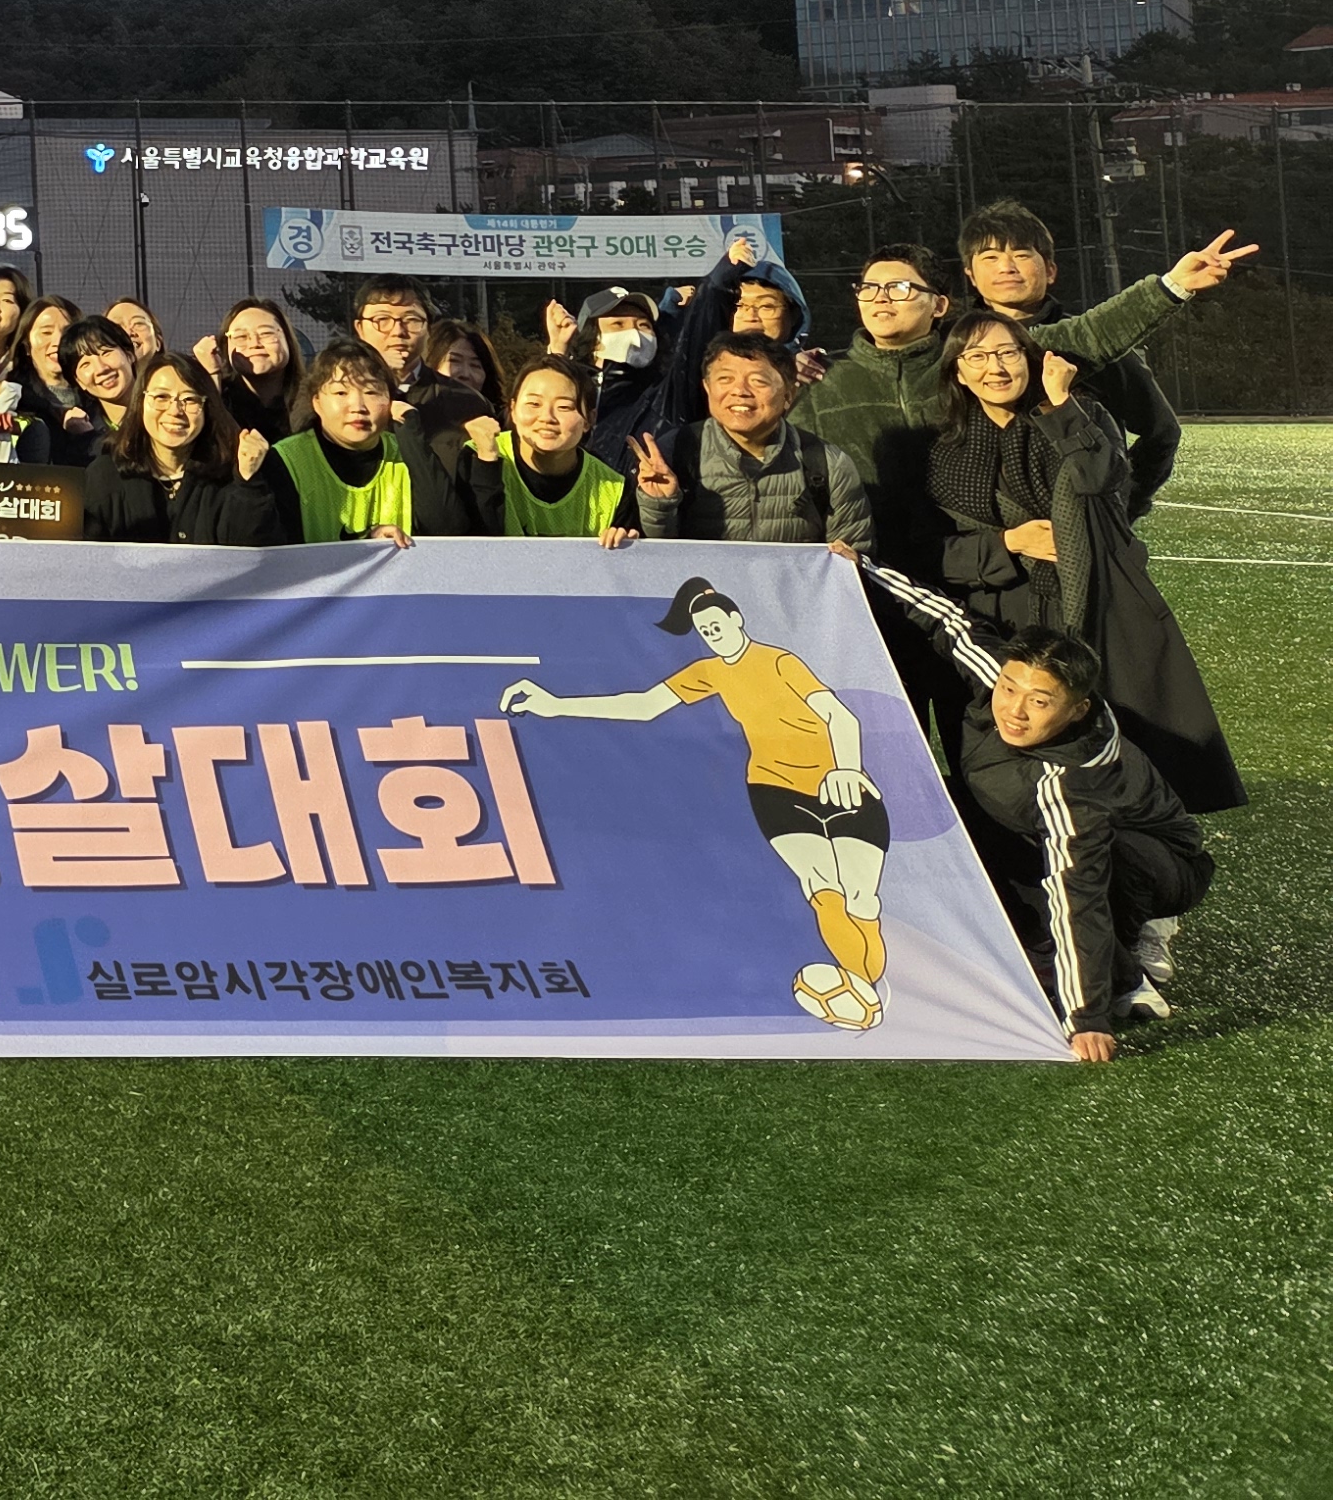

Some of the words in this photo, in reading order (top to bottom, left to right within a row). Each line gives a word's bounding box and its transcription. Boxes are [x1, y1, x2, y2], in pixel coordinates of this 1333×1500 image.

[287, 224, 313, 254] 경
[370, 231, 527, 258] 전국축구한마당
[532, 234, 599, 259] 관악구
[605, 235, 658, 259] 50대
[663, 234, 708, 258] 우승
[483, 259, 532, 271] 서울특별시
[537, 261, 567, 272] 관악구
[86, 959, 593, 1001] 실로암시각장애인복지회
